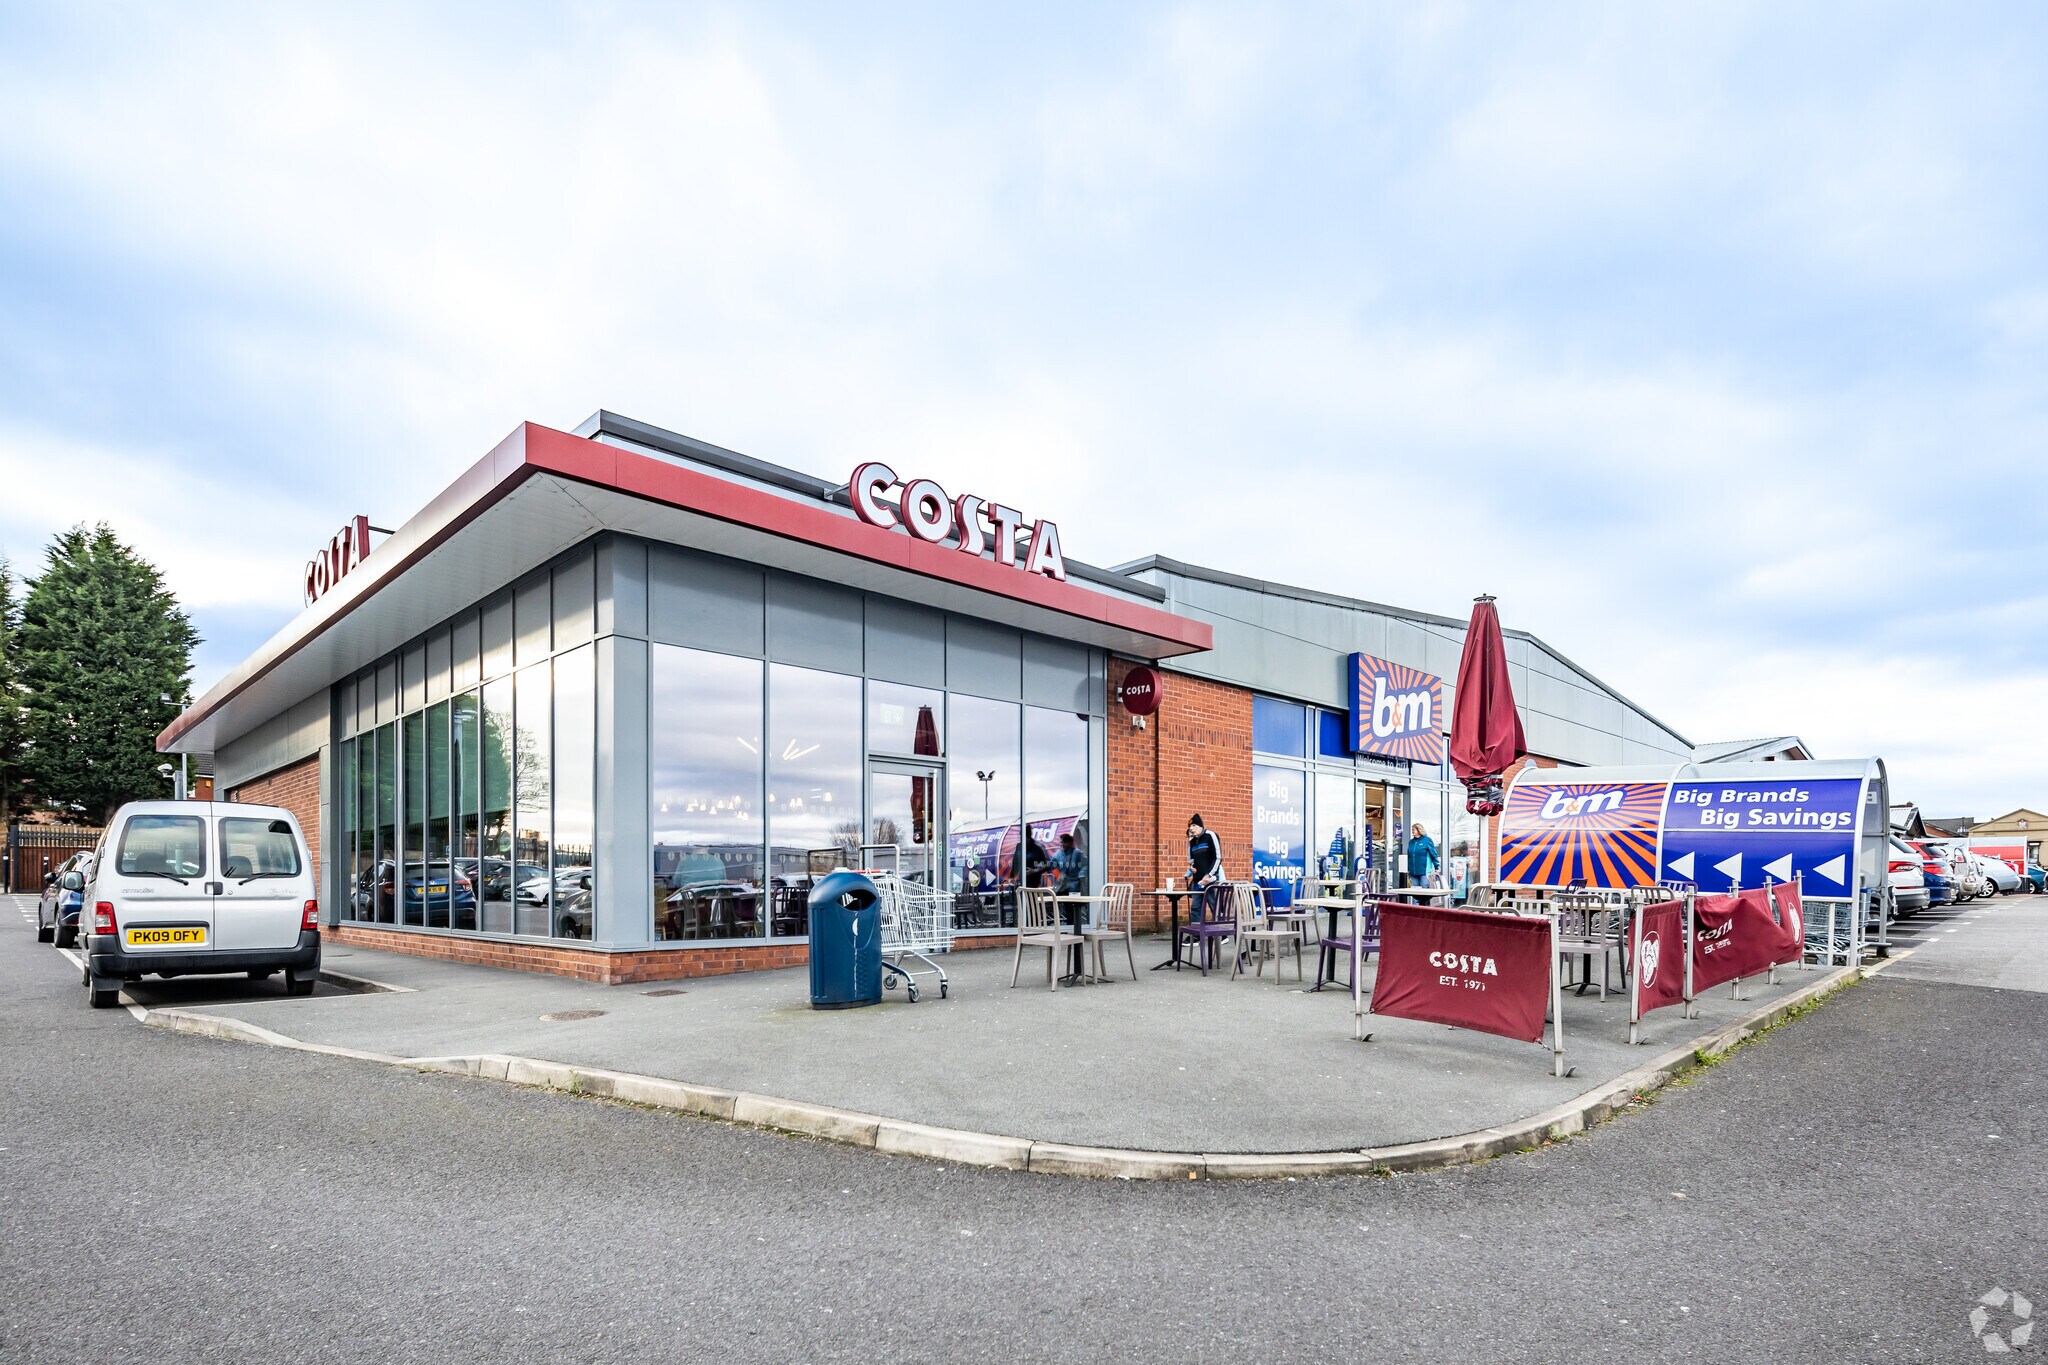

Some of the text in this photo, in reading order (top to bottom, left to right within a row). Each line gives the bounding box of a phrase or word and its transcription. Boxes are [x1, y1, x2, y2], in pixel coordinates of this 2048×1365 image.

[850, 462, 1066, 582] COSTA
[304, 514, 370, 608] COSTA
[1126, 684, 1151, 695] COSTA
[1372, 677, 1432, 738] b&m
[1268, 781, 1289, 803] Big
[1674, 787, 1809, 807] Big Brands
[1539, 789, 1624, 819] b&m
[1257, 805, 1300, 826] Brands
[1700, 808, 1852, 830] Big Savings
[1268, 836, 1289, 859] Big
[1254, 861, 1302, 884] Savings
[133, 930, 200, 943] PK09 OFY
[1429, 951, 1498, 976] COSTA
[1439, 975, 1458, 987] EST.
